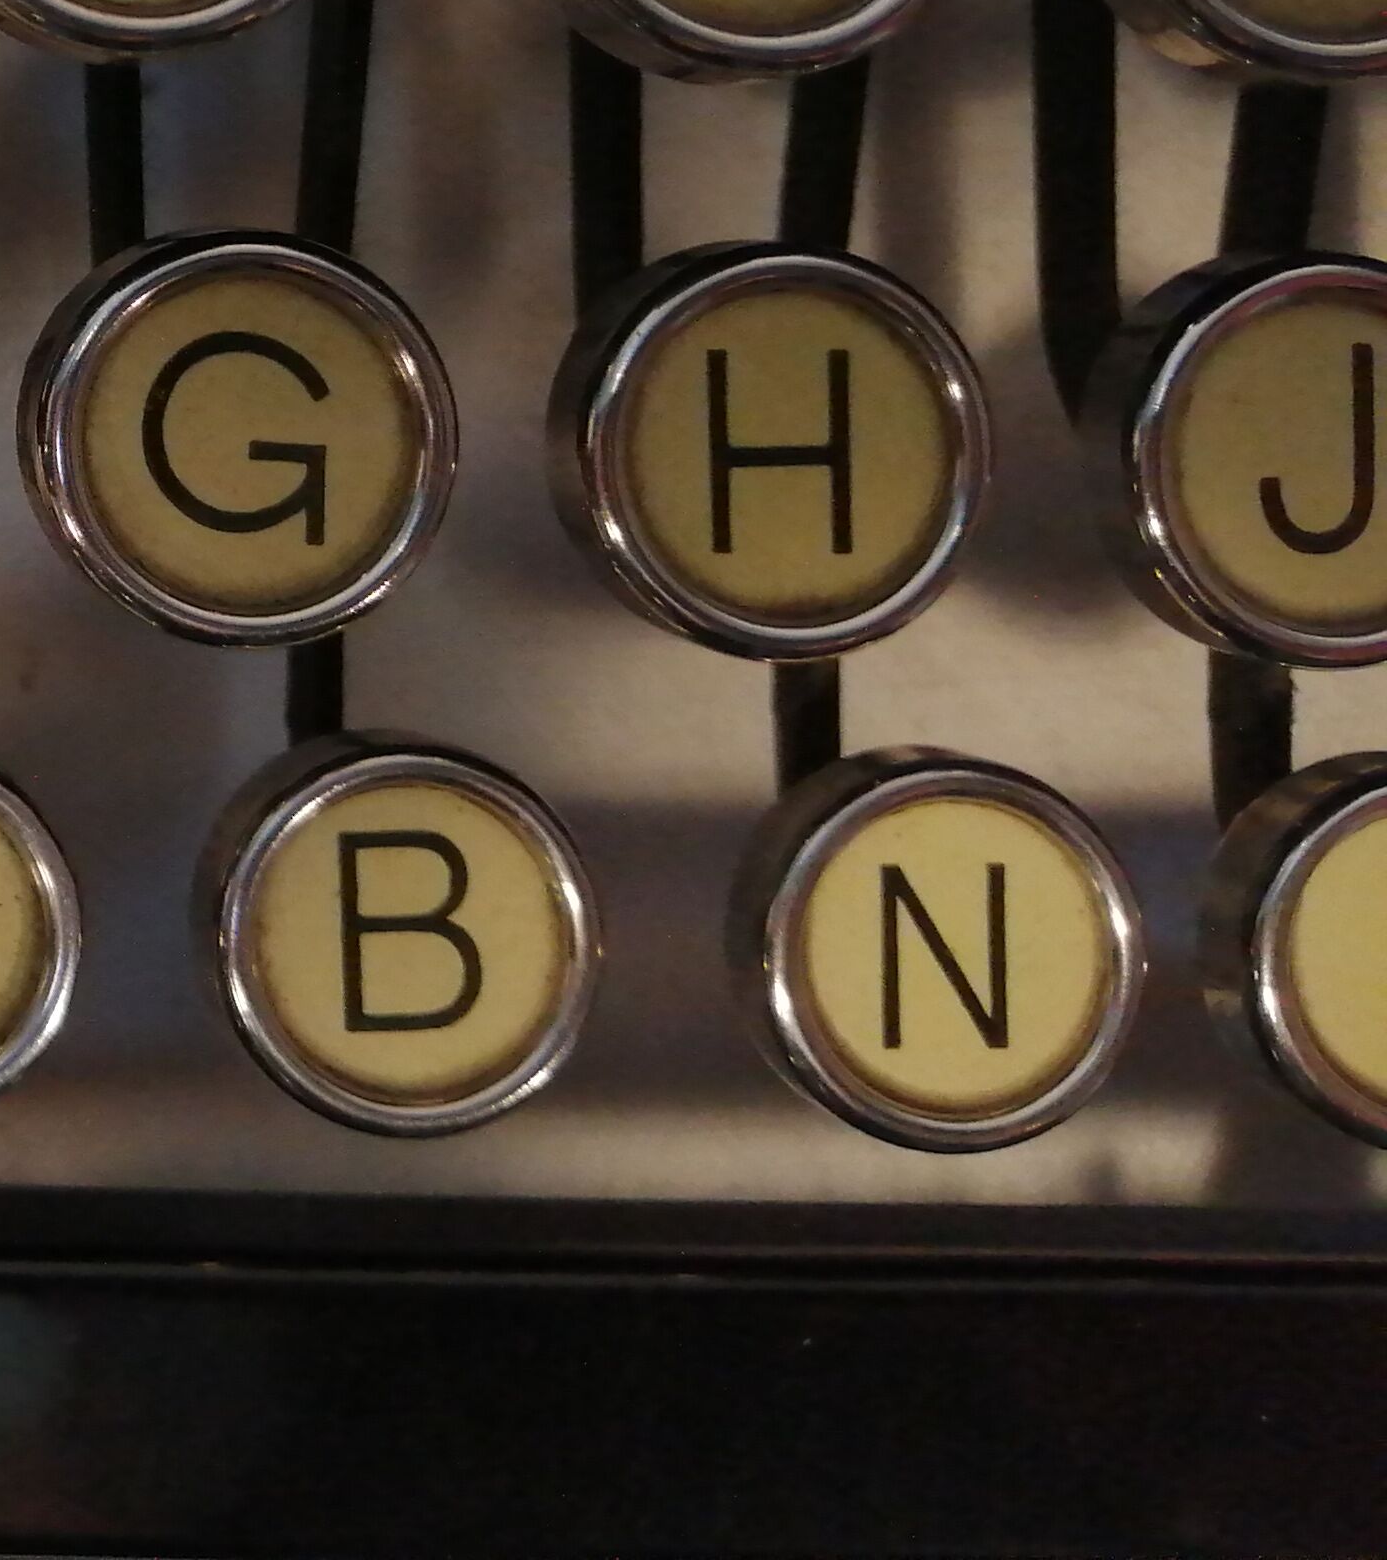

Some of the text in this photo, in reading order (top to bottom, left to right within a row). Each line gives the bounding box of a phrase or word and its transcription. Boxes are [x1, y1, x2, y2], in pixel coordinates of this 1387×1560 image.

[140, 332, 330, 546] G
[705, 347, 853, 555] H
[1259, 342, 1375, 554] J
[338, 830, 482, 1033] B
[881, 864, 1008, 1049] N
